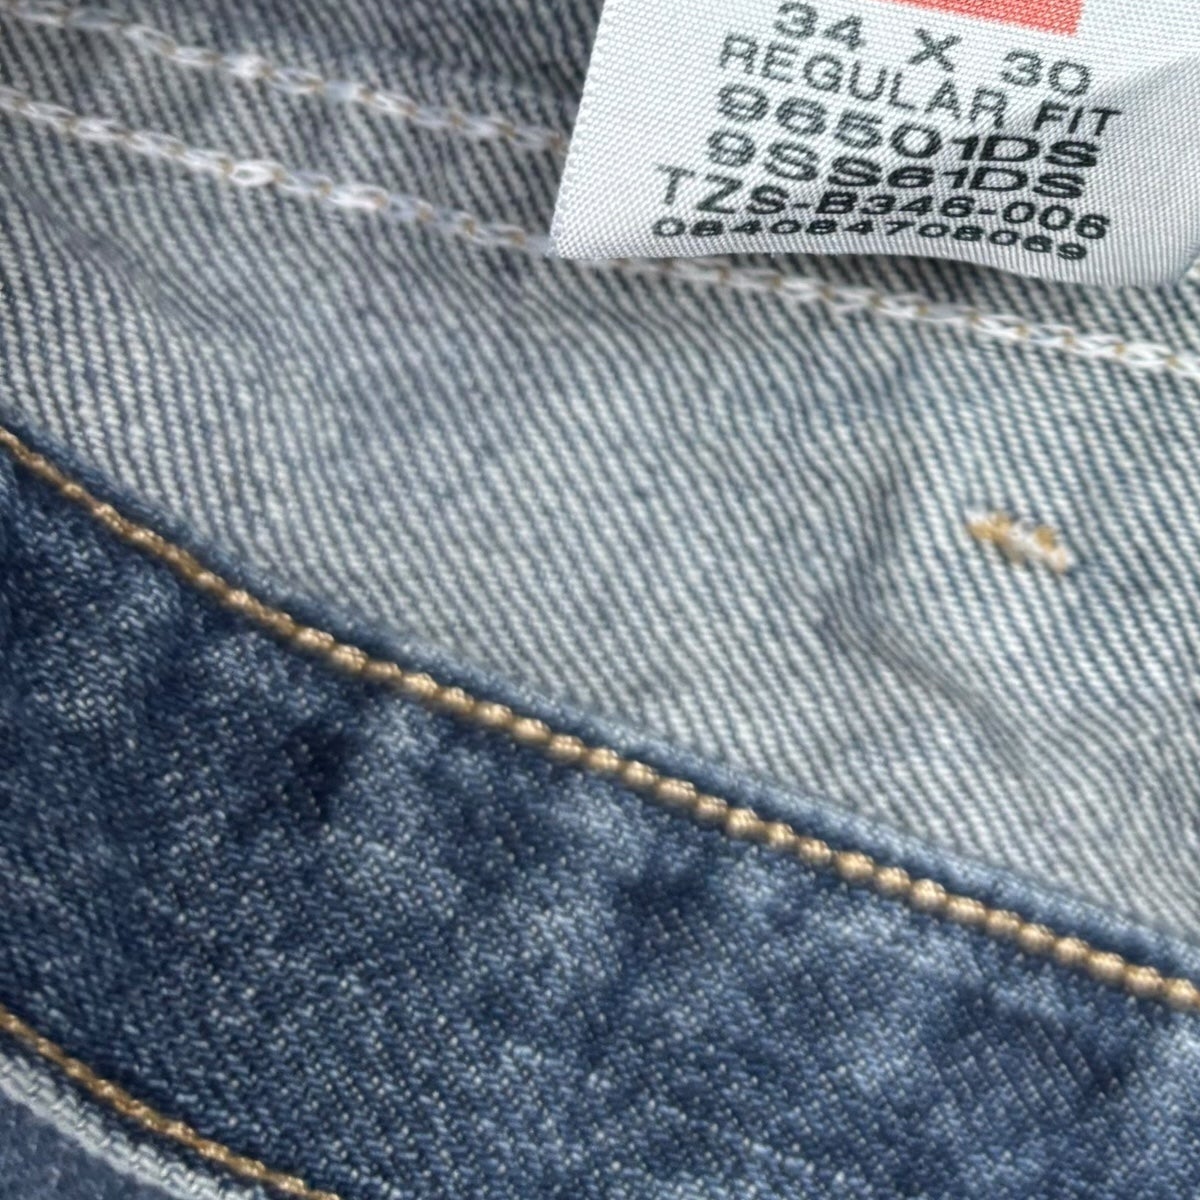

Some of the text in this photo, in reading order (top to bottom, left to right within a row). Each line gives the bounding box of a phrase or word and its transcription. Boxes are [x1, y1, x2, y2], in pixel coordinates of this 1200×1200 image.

[717, 33, 1123, 137] REGULAR FIT
[774, 0, 1092, 97] 34 X 30
[716, 83, 1101, 168] 96501DS
